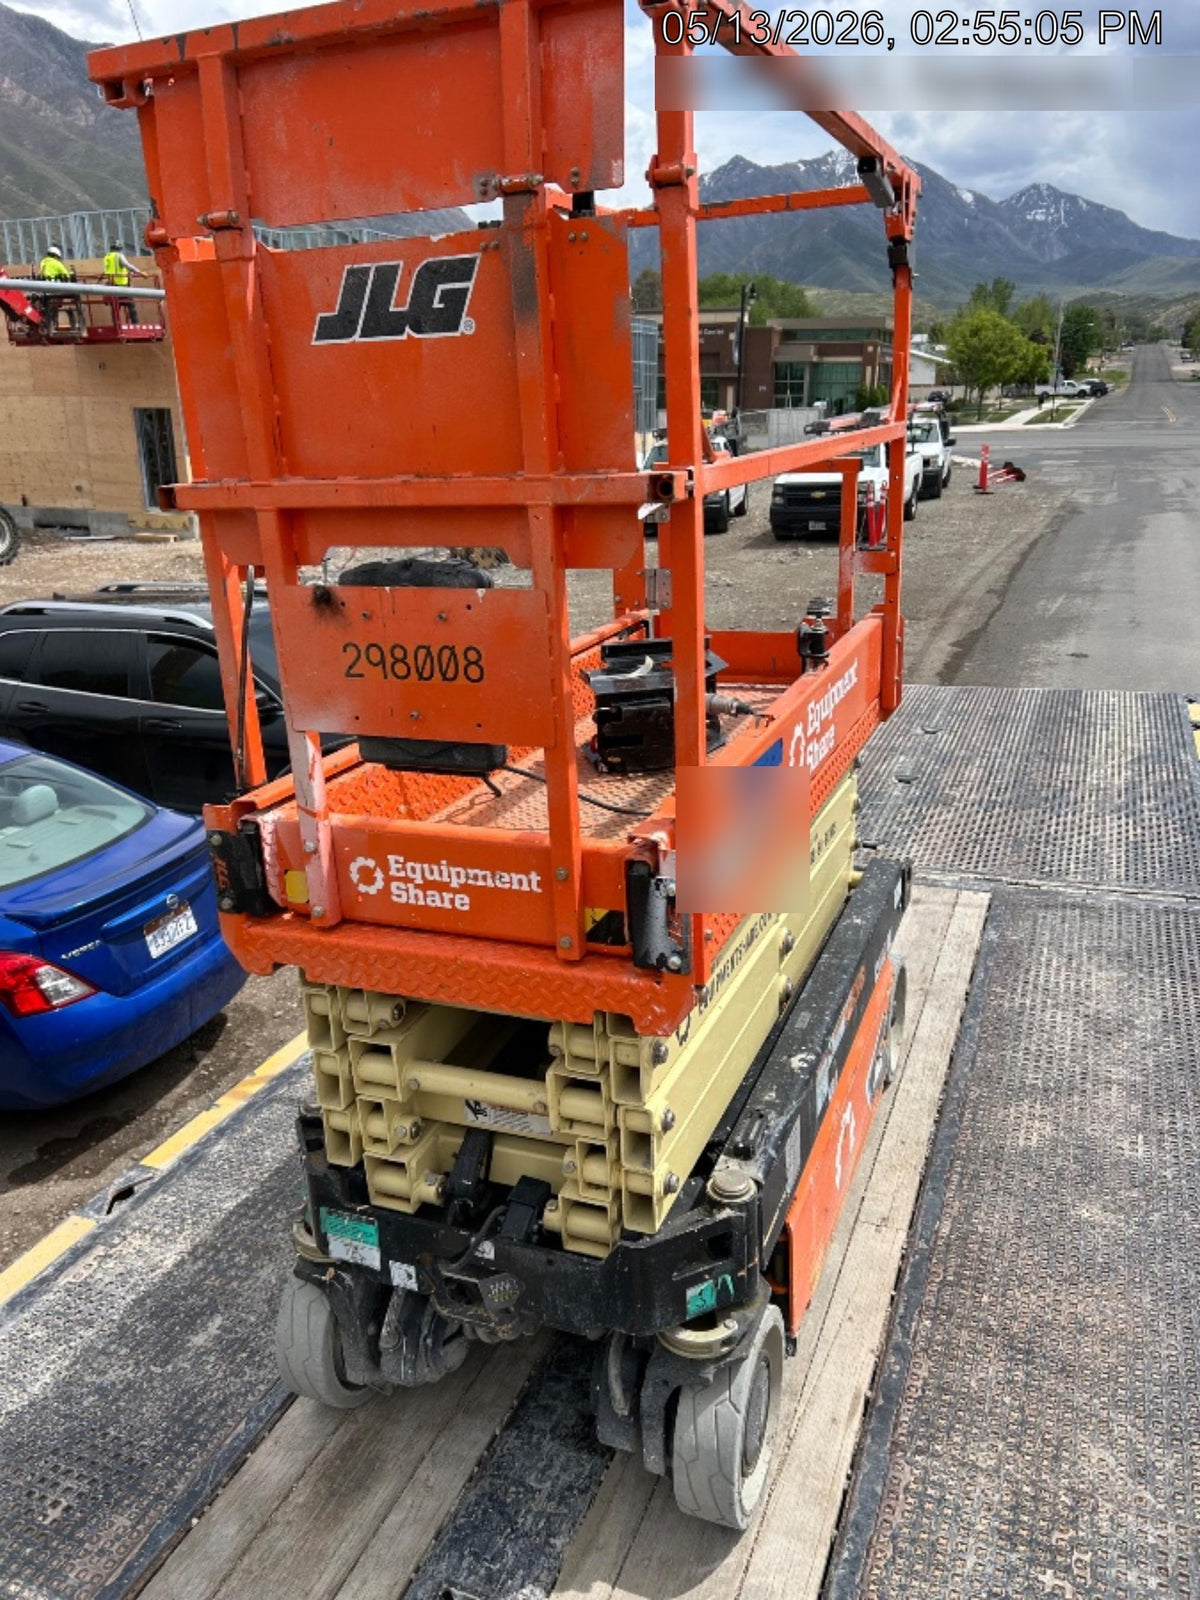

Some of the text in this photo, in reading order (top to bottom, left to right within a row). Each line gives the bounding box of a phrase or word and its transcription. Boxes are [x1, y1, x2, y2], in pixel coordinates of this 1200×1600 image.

[341, 641, 485, 683] 298008
[387, 854, 543, 894] Equipment
[390, 881, 471, 912] Share
